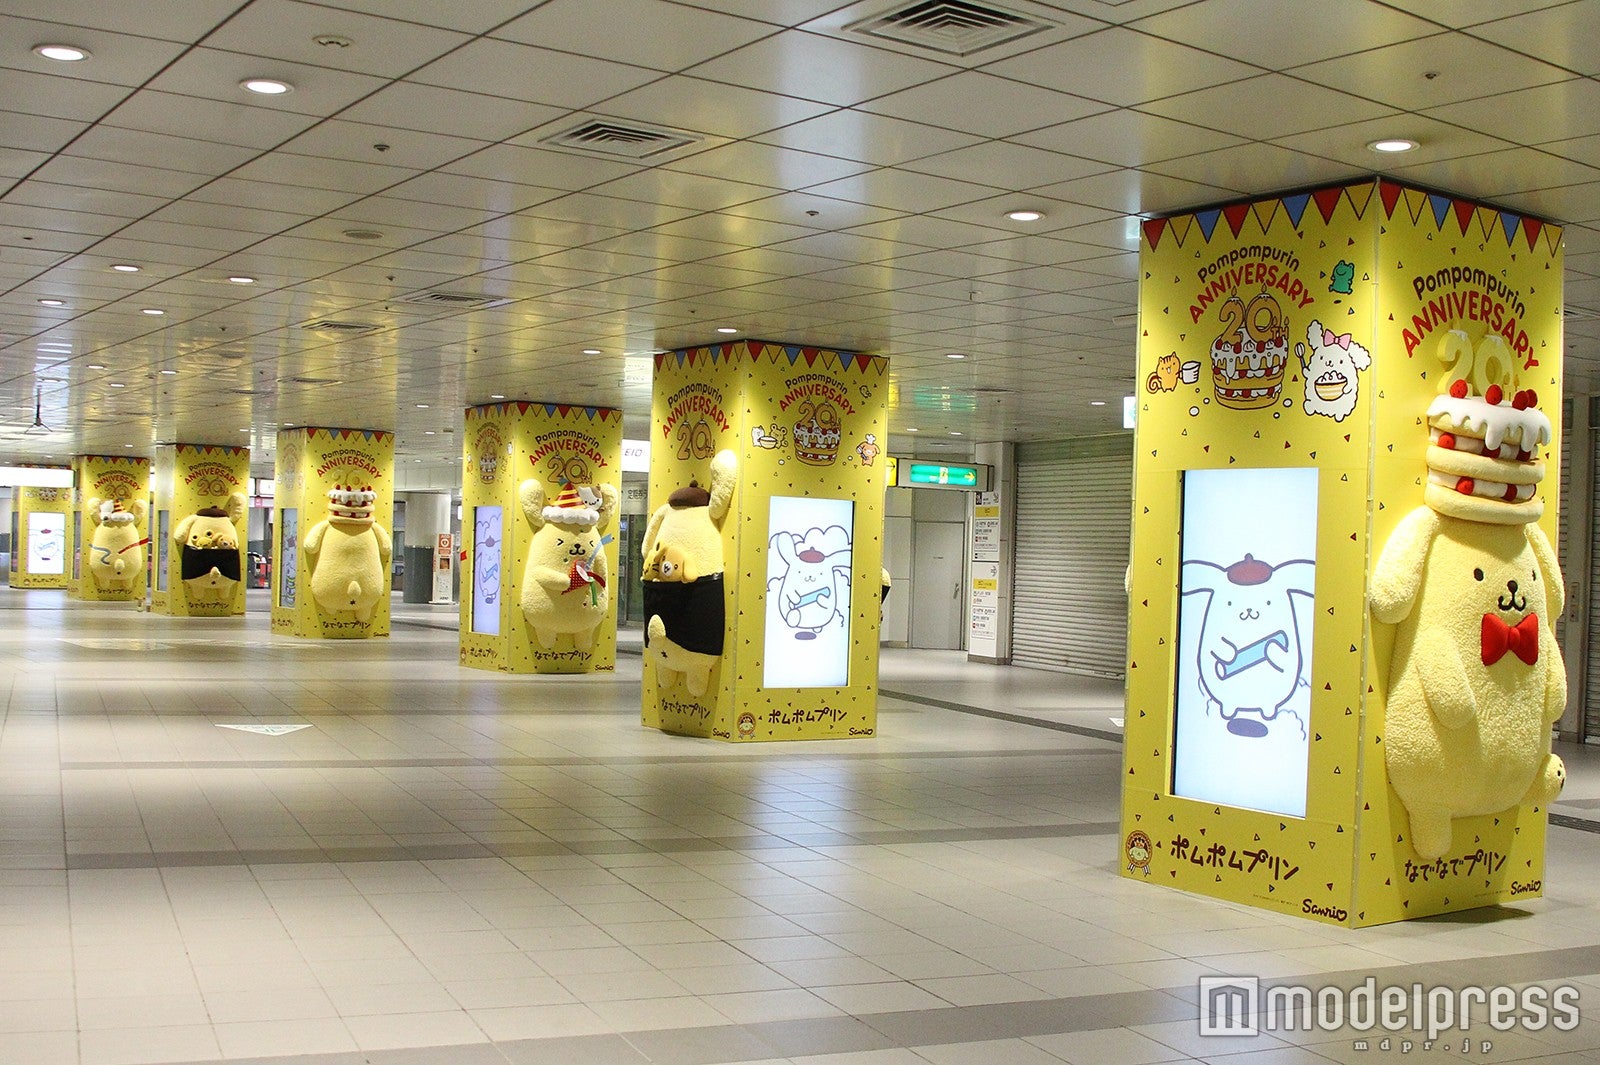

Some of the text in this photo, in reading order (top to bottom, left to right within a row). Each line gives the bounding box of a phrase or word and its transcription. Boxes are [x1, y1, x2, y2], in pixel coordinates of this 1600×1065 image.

[1197, 245, 1300, 284] Pompompurin
[1189, 263, 1315, 325] ANNIVERSARY
[1412, 266, 1526, 320] Pompompurin
[1402, 290, 1539, 371] ANNIVERSARY
[667, 382, 723, 409] Pompompurin
[784, 373, 848, 395] Pompompurin
[779, 383, 856, 416] ANNIVERSARY
[662, 395, 730, 440] ANNIVERSARY
[529, 438, 608, 468] ANNIVERSARY
[535, 430, 600, 449] Pompompurin
[184, 467, 240, 486] ANNIVERSARY
[316, 455, 382, 478] ANNIVERSARY
[534, 650, 592, 661] なでなでプリン
[661, 697, 711, 720] なでなでプリン
[768, 706, 848, 725] ポムポムプリン
[1170, 834, 1299, 881] ポムポムプリン
[1404, 849, 1507, 883] なでなでプリン
[1302, 898, 1348, 922] Sanrio
